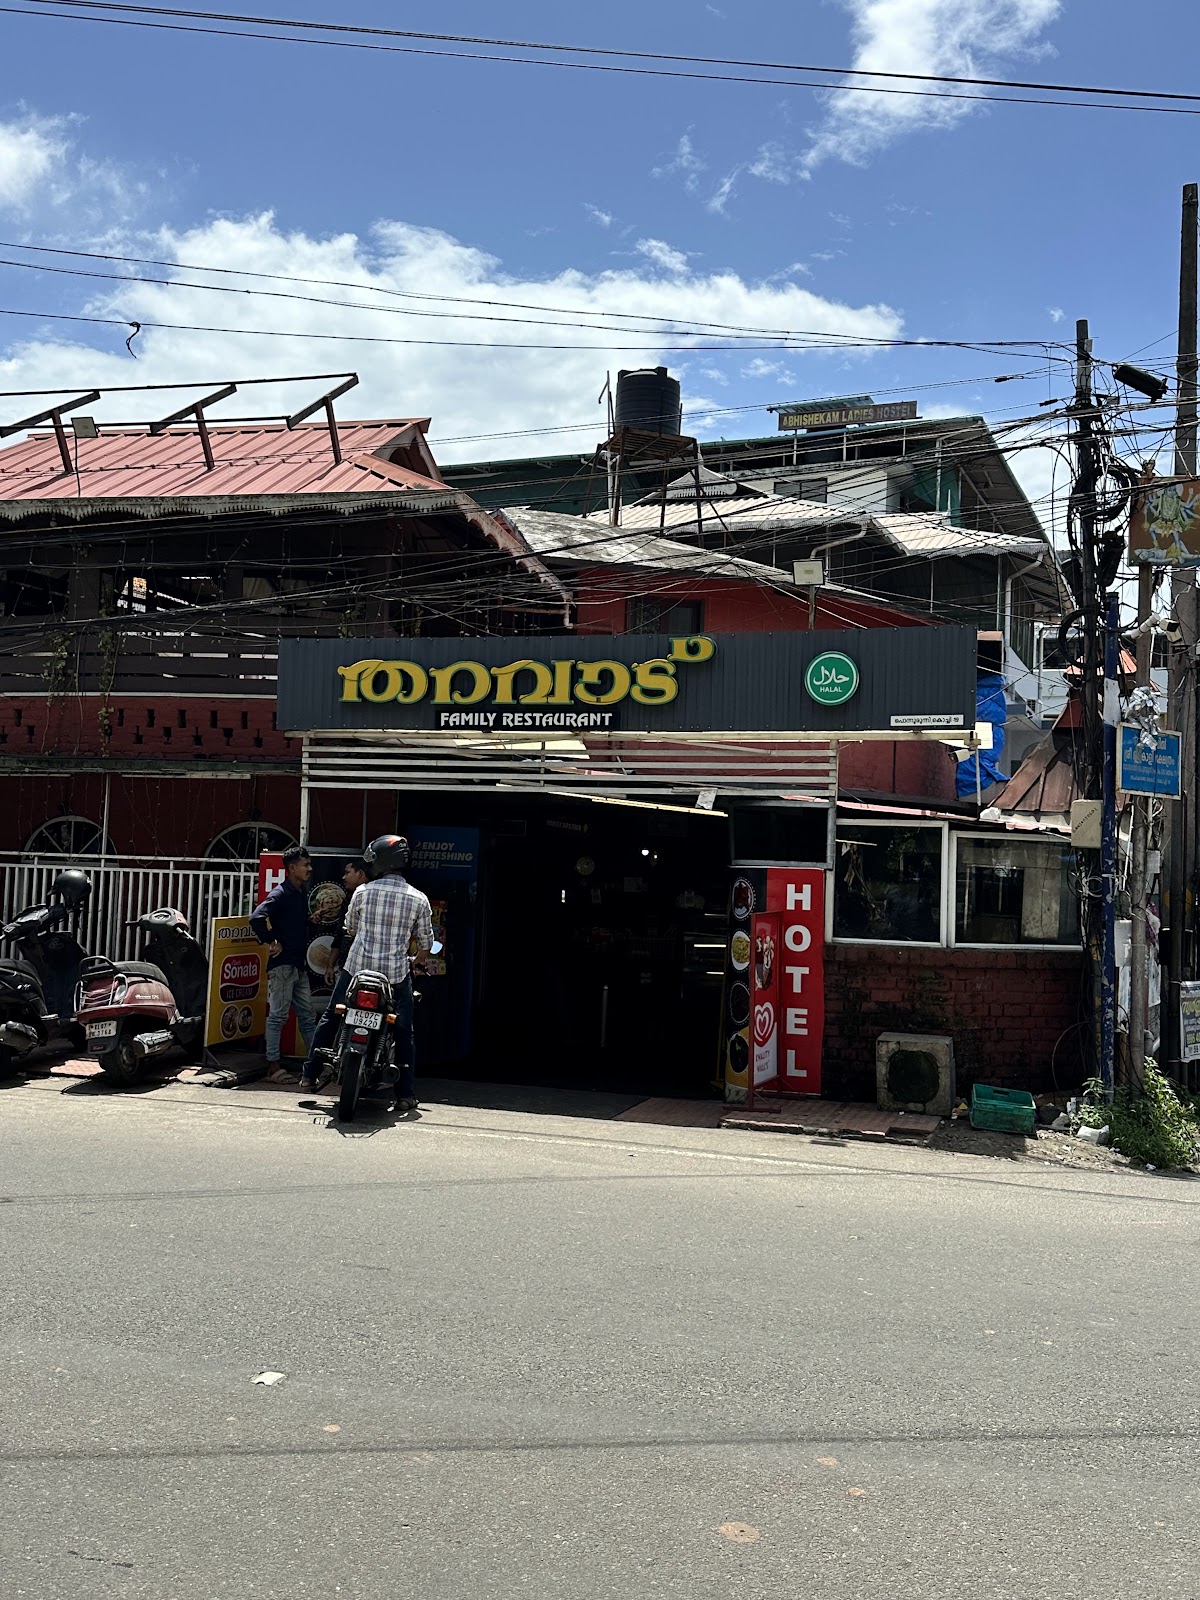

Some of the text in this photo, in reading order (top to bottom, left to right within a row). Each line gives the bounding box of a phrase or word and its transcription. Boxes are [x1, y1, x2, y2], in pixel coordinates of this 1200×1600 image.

[782, 411, 840, 427] ABHISHEKAM
[841, 407, 874, 423] LADIES
[337, 635, 718, 706] തറവാട്
[813, 665, 850, 686] حلال
[440, 712, 613, 728] FAMILY RESTAURANT
[421, 842, 456, 851] ENJOY
[411, 850, 474, 862] REFRESHING
[411, 861, 440, 870] PEPSI
[223, 961, 258, 980] Sonata
[784, 883, 812, 1078] HOTEL
[226, 986, 253, 999] ICE CREAM
